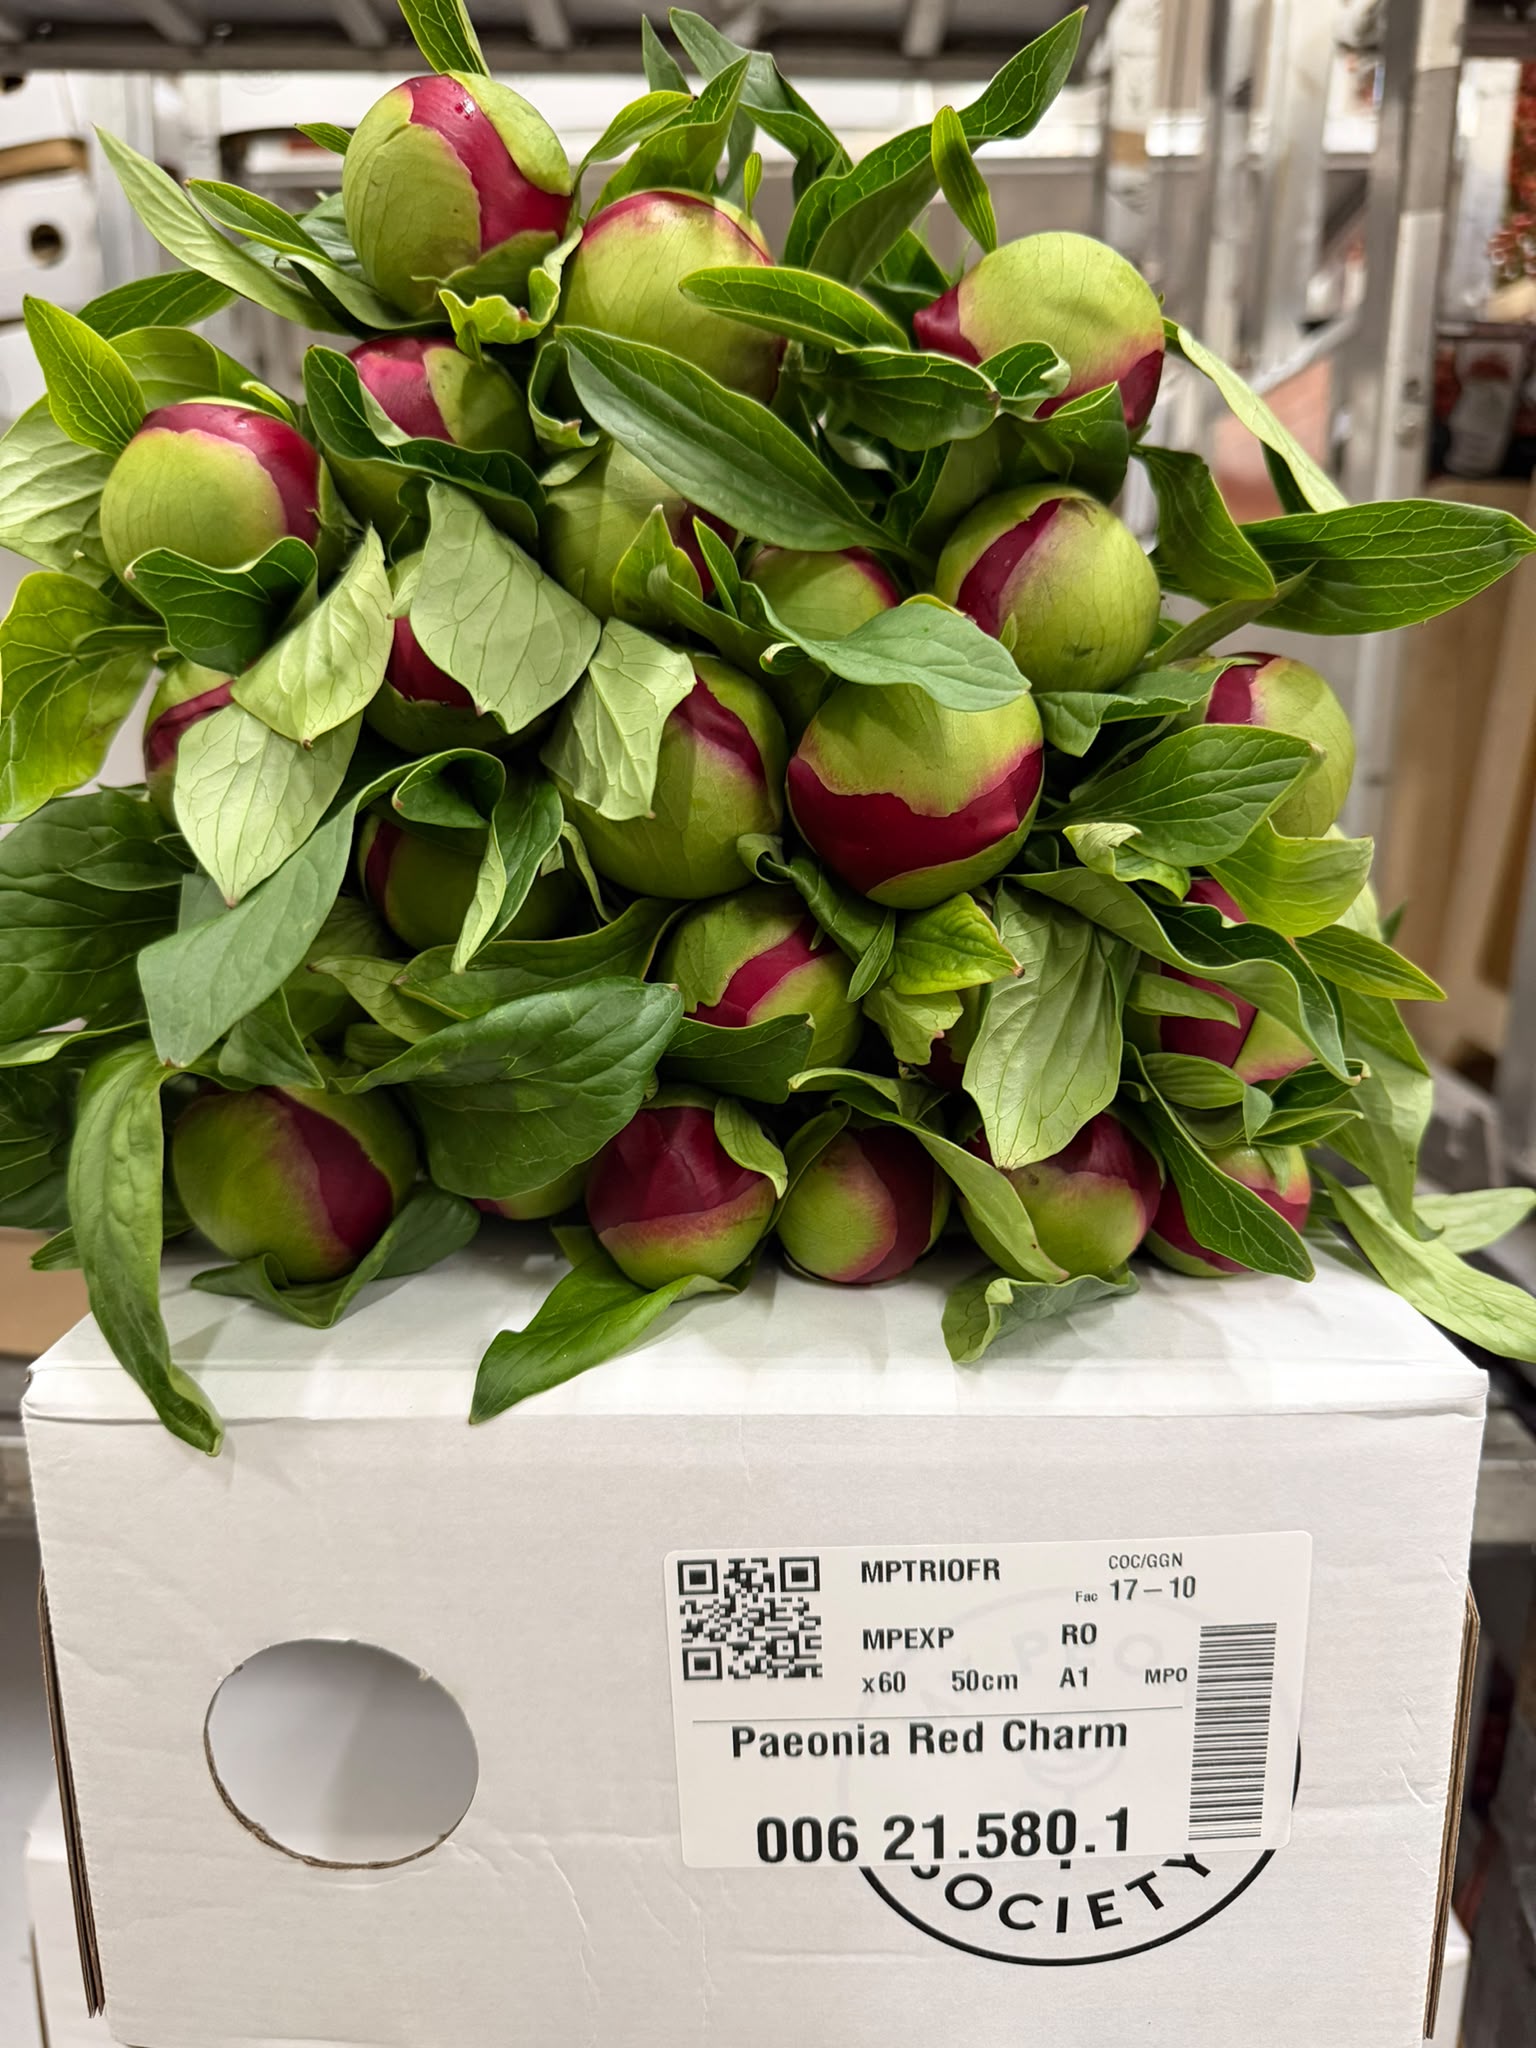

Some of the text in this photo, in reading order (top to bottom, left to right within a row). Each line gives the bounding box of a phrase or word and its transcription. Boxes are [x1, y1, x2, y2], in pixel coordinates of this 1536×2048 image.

[861, 1558, 1000, 1584] MPTRIOFR
[1108, 1553, 1183, 1570] COC/GGN
[1075, 1591, 1098, 1603] Fac
[862, 1623, 1097, 1650] MPEXP RO
[862, 1666, 1188, 1694] x60 50cm A1 MPO
[732, 1719, 1127, 1758] Paeonia Red Charm
[756, 1807, 1128, 1864] 006 21.580.1
